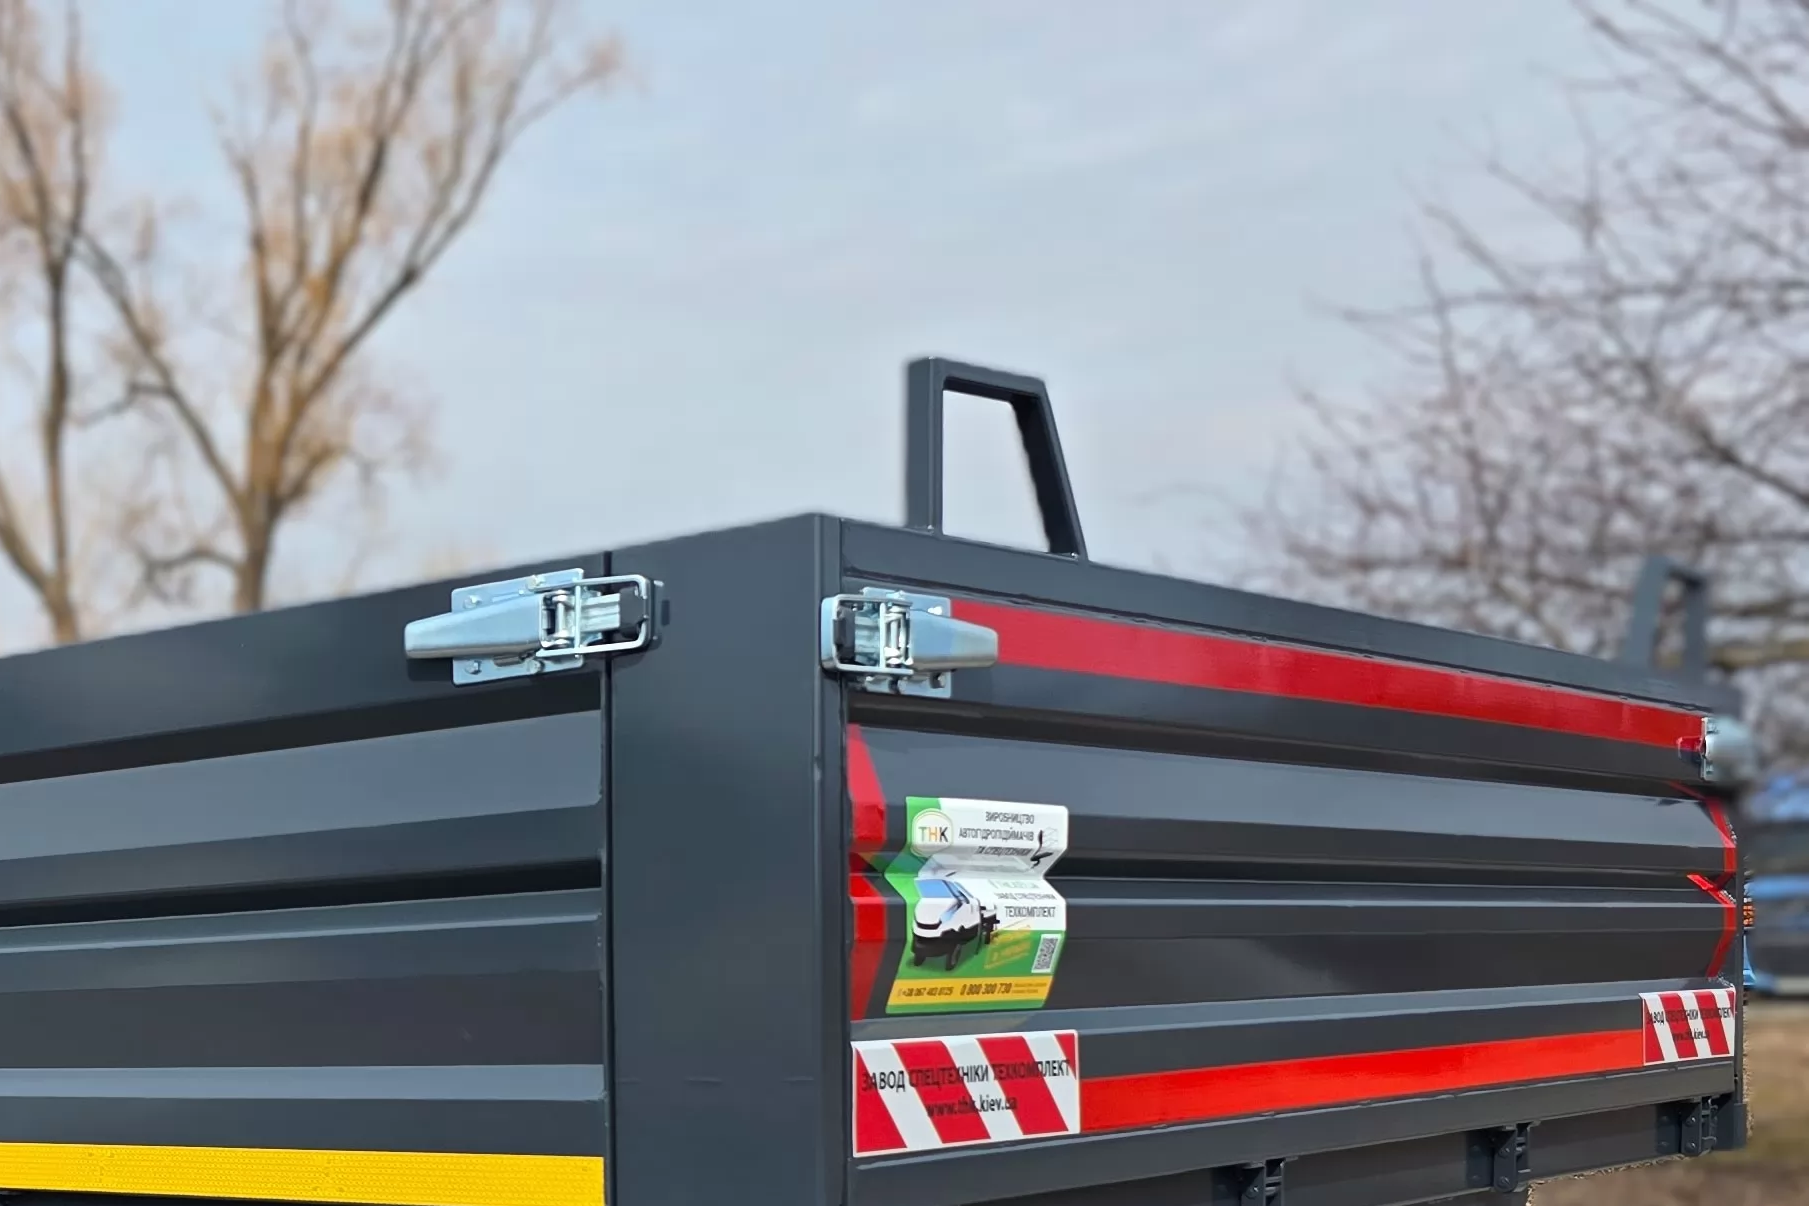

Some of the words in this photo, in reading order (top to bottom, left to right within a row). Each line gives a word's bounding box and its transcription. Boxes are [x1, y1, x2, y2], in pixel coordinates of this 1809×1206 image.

[861, 1071, 906, 1093] ЗАВОД
[908, 1064, 989, 1091] СПЕЦТЕХНІКИ
[993, 1059, 1070, 1081] ТЕХКОМПЛЕКТ
[926, 1095, 1018, 1117] www.thk.kiev.ua
